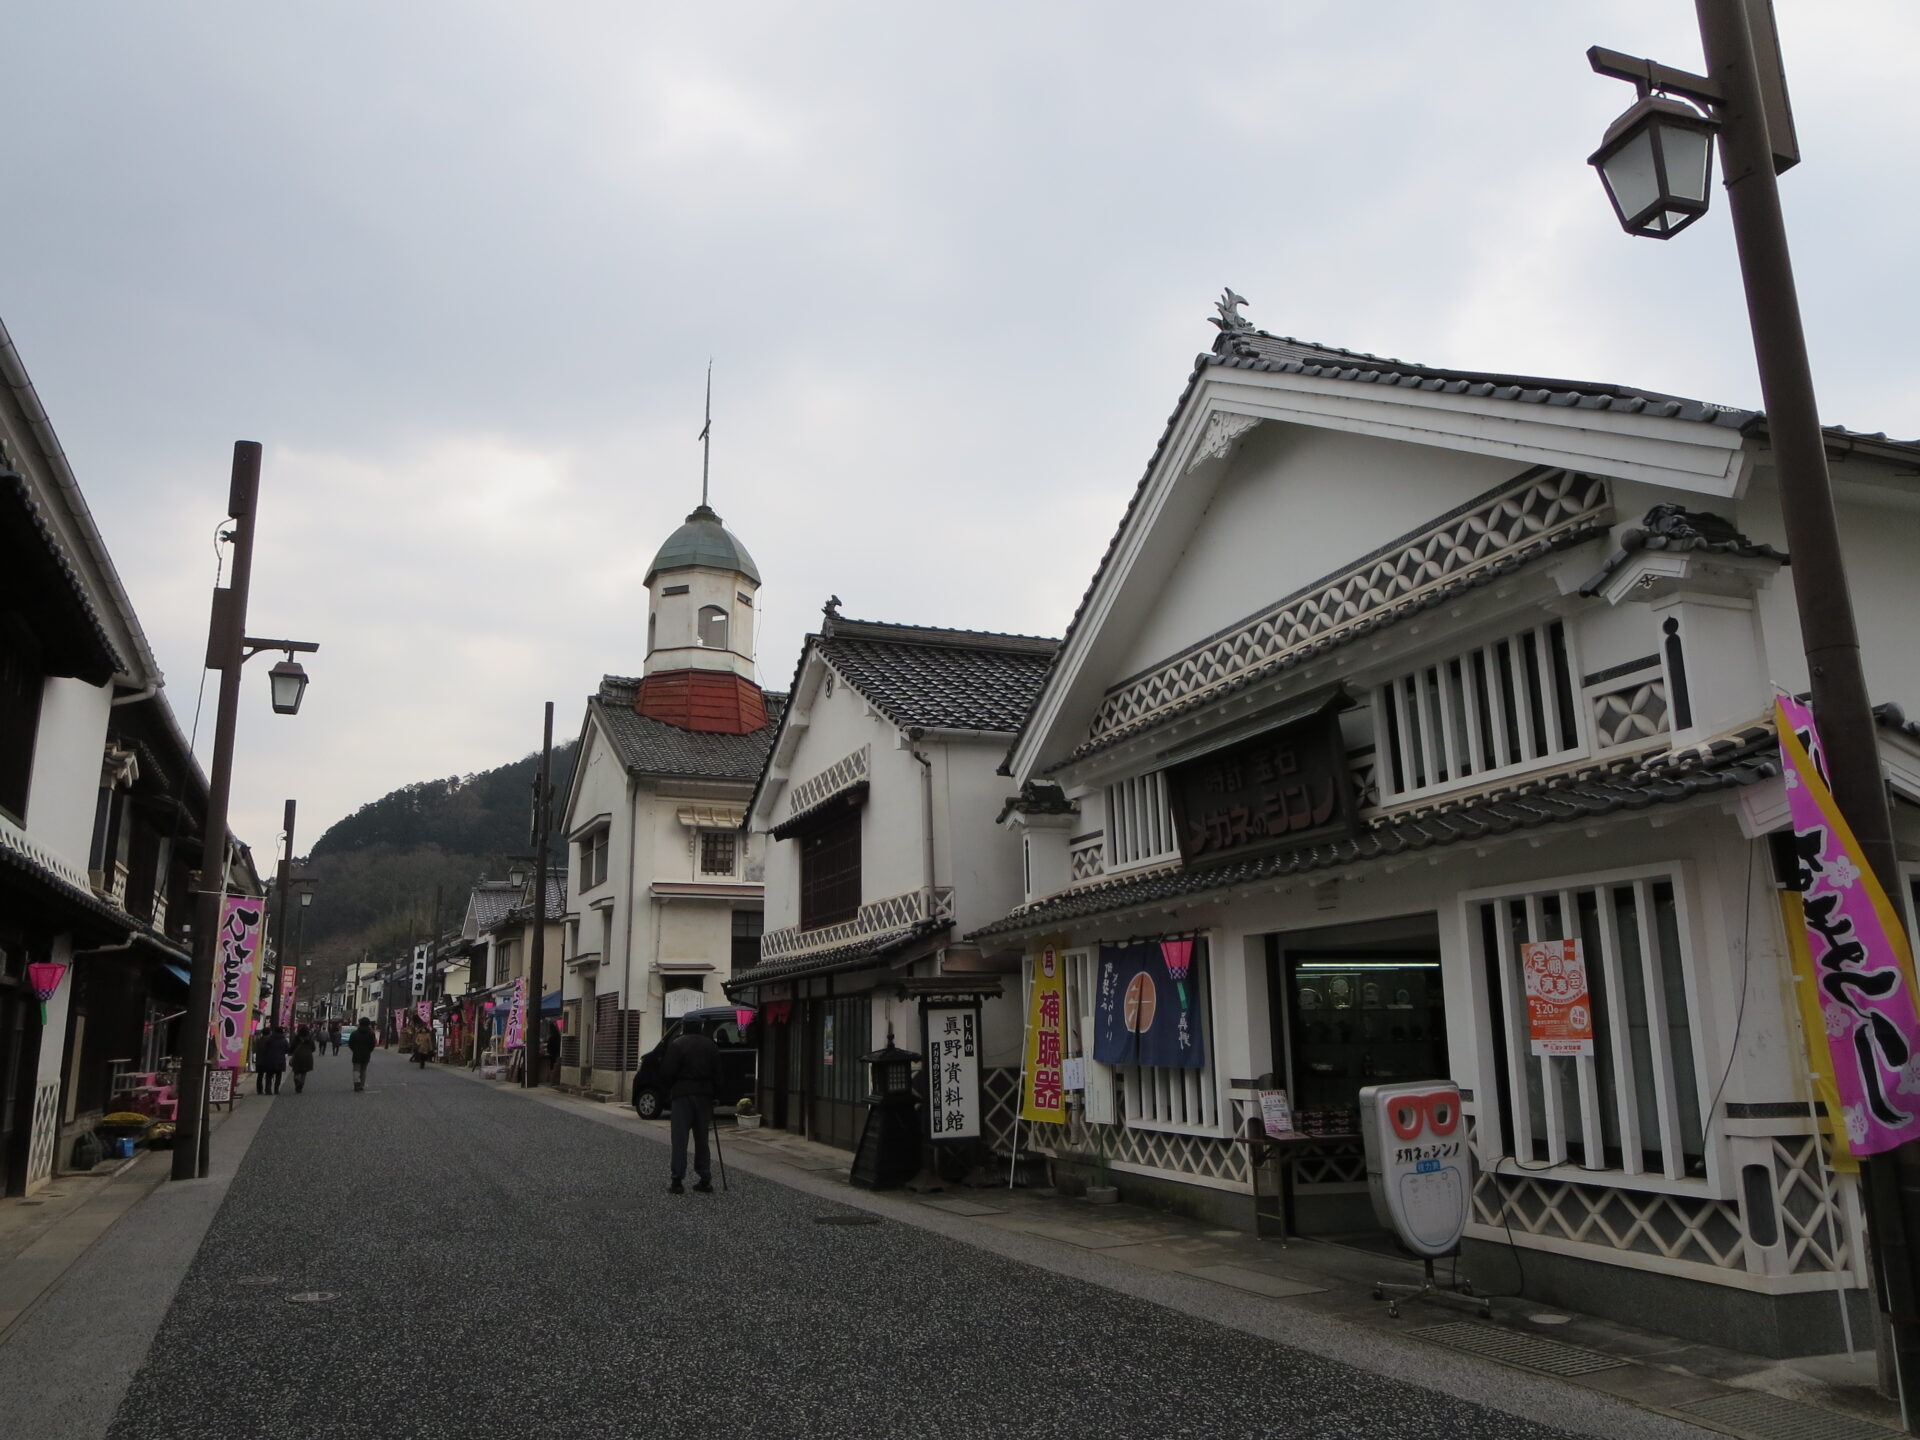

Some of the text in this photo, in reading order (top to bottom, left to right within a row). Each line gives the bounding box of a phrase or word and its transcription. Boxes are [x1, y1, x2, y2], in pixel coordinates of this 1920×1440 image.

[1255, 745, 1298, 784] 宝石
[1189, 777, 1336, 856] メガネのシンノ
[1044, 949, 1054, 972] 耳
[965, 1018, 974, 1053] しんの
[1034, 990, 1063, 1111] 補聴器
[943, 1015, 965, 1132] 眞野資料館
[1395, 1141, 1460, 1164] メガネのシンノ
